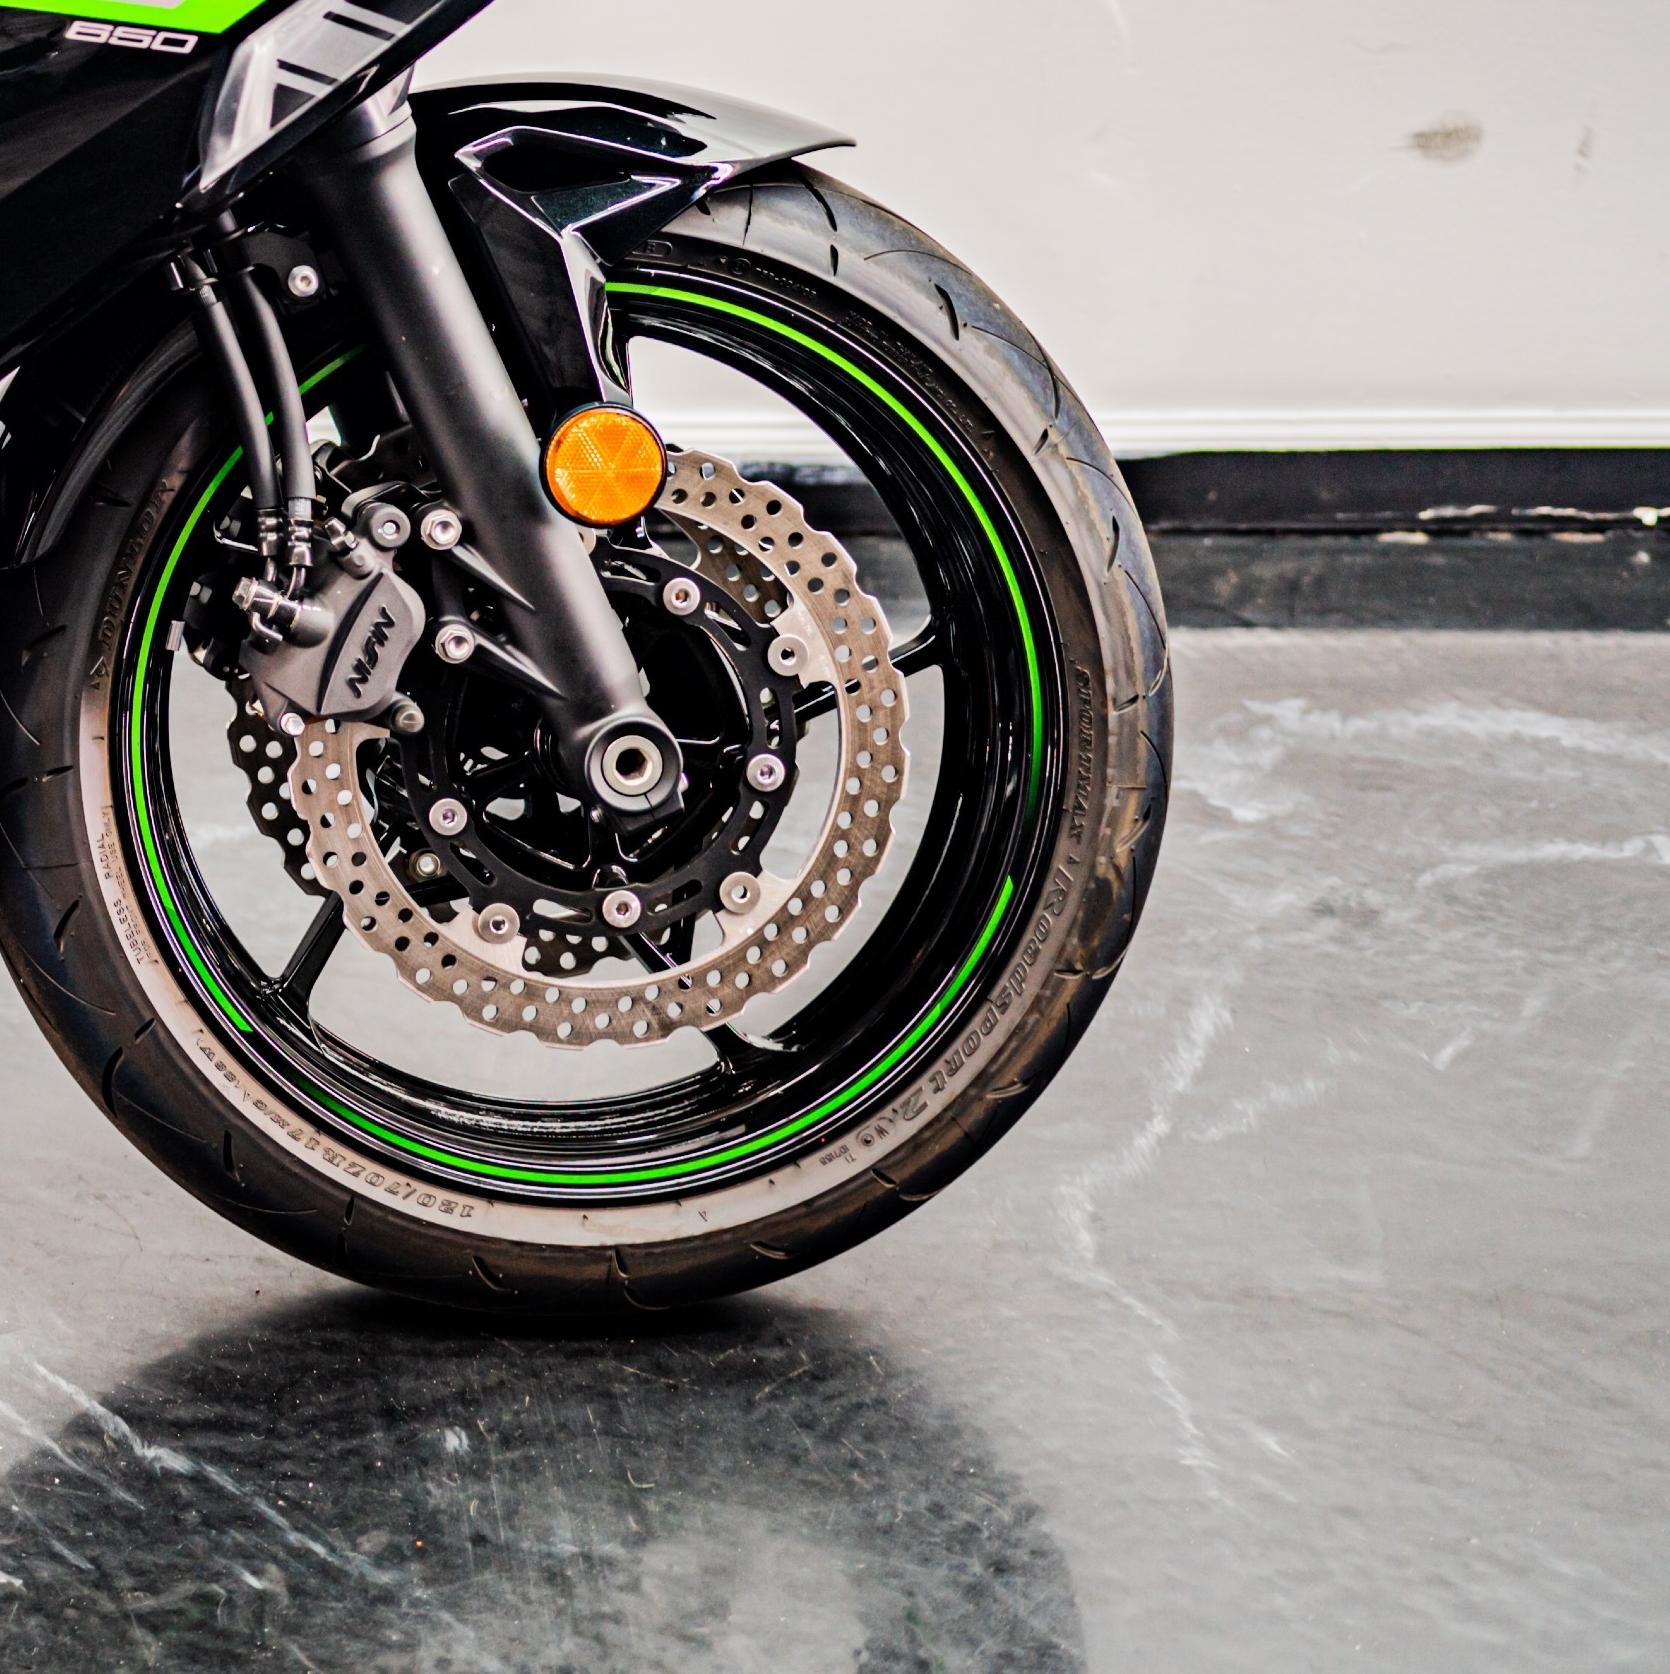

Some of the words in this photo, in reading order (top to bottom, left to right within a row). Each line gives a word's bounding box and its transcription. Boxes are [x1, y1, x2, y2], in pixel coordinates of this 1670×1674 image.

[64, 20, 199, 55] 650
[99, 480, 172, 648] DUNLOP
[1065, 663, 1094, 847] SPORTMAX
[96, 832, 114, 880] RADIAL
[112, 898, 145, 965] TUBELESS
[925, 866, 1074, 1097] Roadsport
